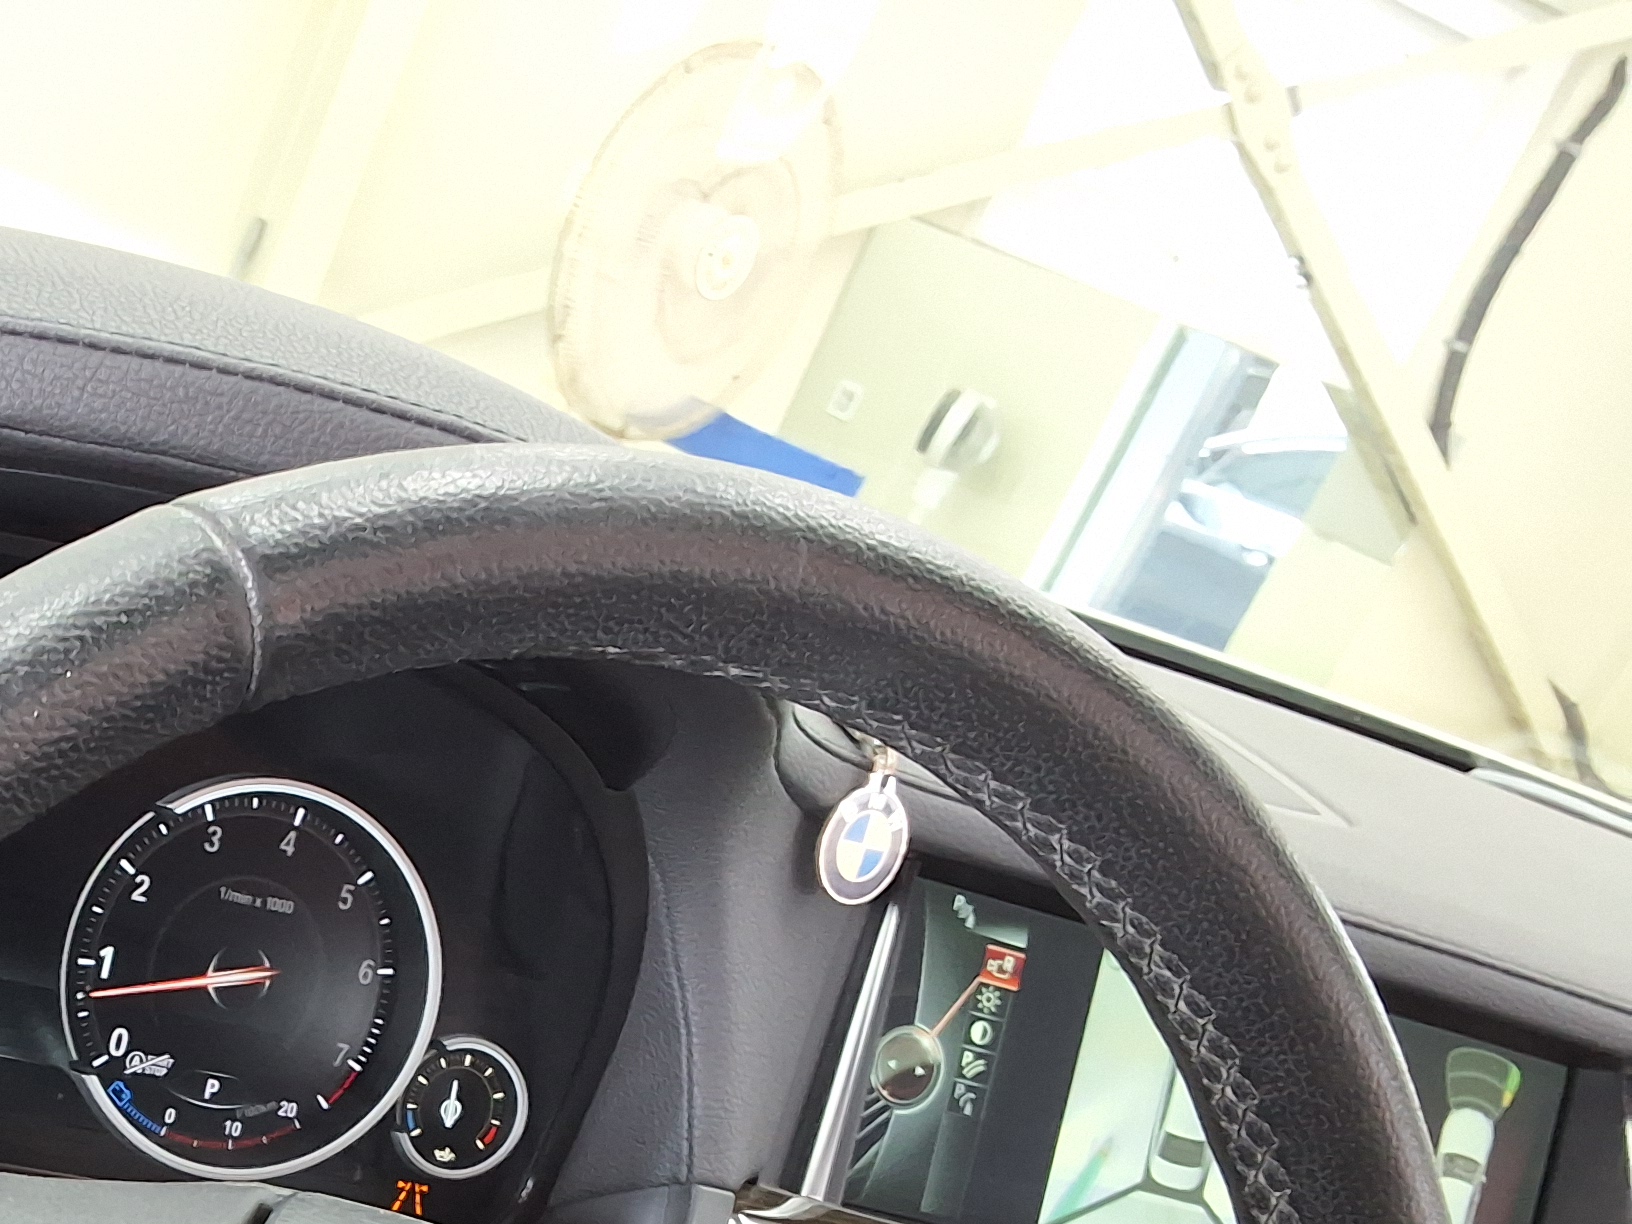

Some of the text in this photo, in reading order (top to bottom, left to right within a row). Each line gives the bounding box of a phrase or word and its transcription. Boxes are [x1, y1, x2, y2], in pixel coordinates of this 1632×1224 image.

[204, 826, 222, 853] 3
[279, 831, 297, 857] 4
[131, 875, 151, 902] 2
[338, 884, 354, 910] 5
[266, 896, 295, 914] 1000
[98, 946, 116, 979] 1
[359, 960, 375, 985] 6
[108, 1027, 129, 1057] 0
[333, 1042, 349, 1067] 7
[204, 1078, 221, 1100] P
[165, 1107, 176, 1124] 0
[277, 1101, 299, 1118] 20
[224, 1119, 243, 1137] 10
